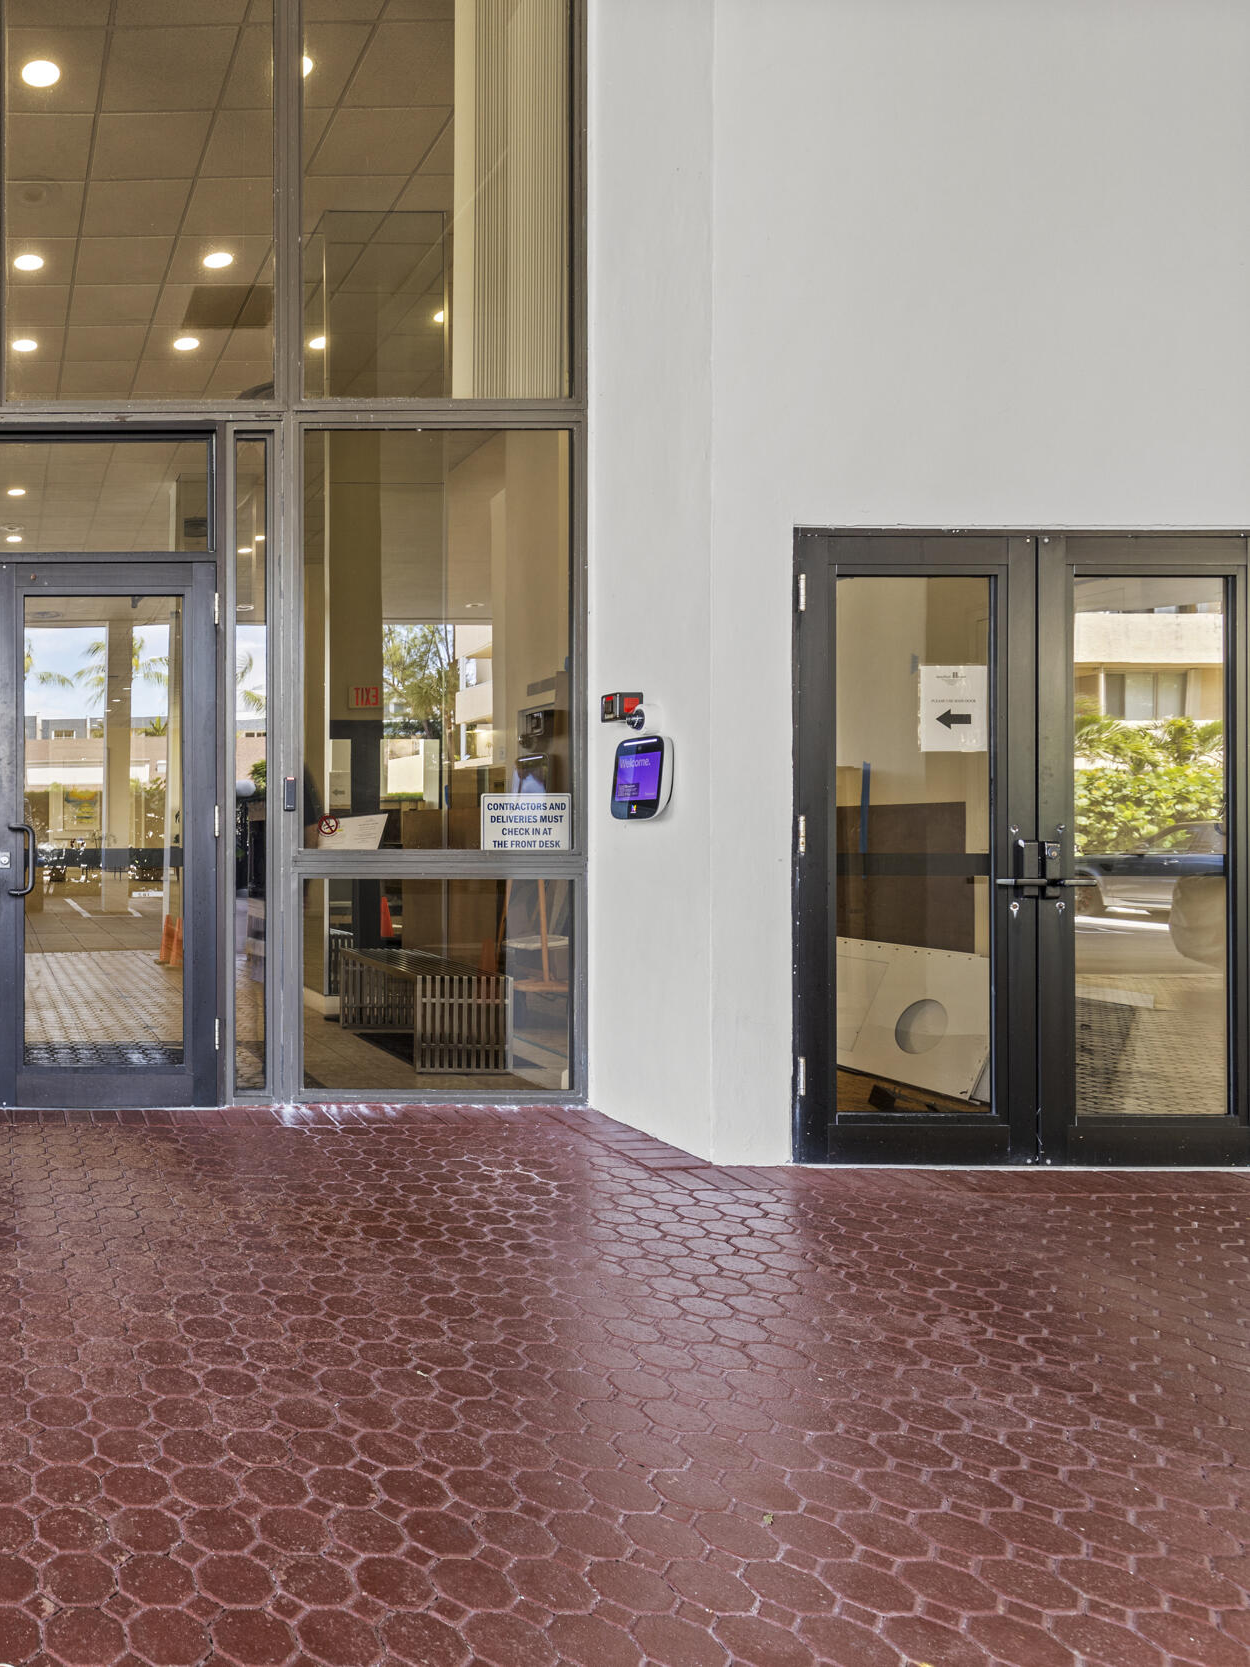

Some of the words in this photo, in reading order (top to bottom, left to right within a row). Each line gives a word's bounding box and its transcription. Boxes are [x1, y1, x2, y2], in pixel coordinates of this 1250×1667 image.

[620, 757, 651, 769] Welcome.
[487, 803, 547, 811] CONTRACTORS
[549, 803, 566, 811] AND
[490, 815, 537, 823] DELIVERIES
[539, 815, 564, 823] MUST
[502, 828, 530, 836] CHECK
[532, 828, 540, 836] IN
[542, 828, 552, 836] AT
[493, 840, 508, 848] THE
[510, 840, 537, 848] FRONT
[539, 840, 561, 848] DESK
